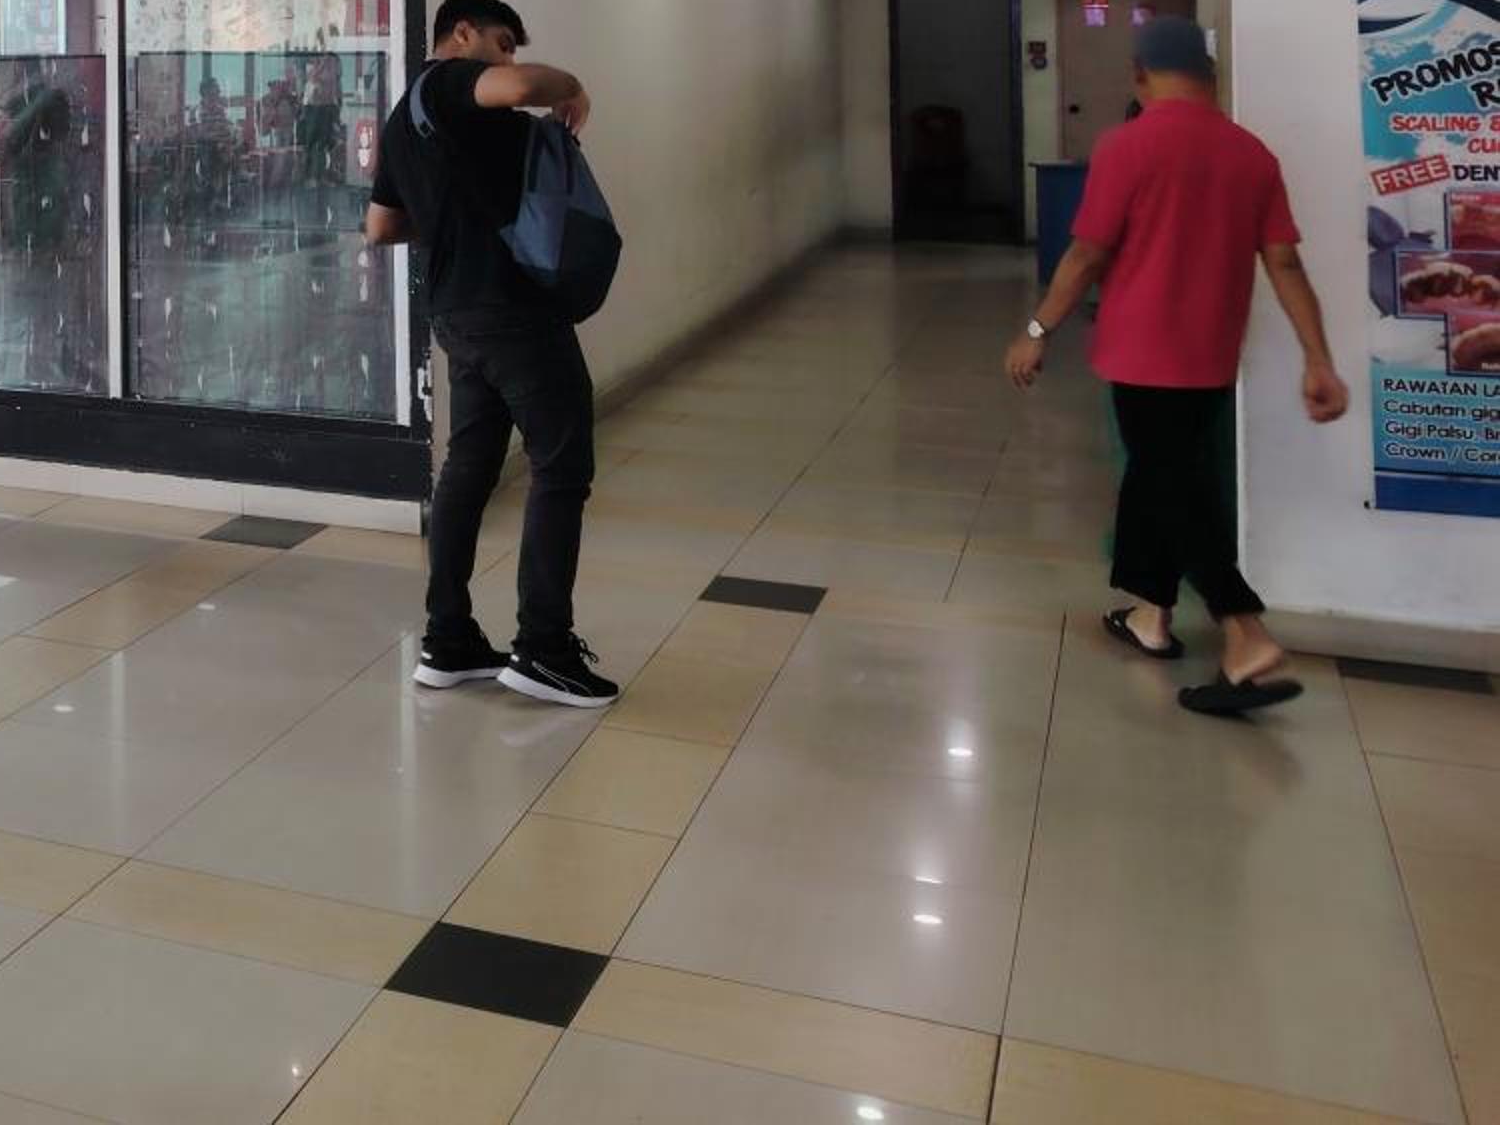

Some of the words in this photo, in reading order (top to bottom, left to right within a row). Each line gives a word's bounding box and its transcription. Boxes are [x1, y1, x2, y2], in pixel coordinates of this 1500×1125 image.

[1392, 115, 1481, 132] SCALING
[1374, 158, 1448, 193] FREE
[1383, 378, 1478, 396] RAWATAN
[1384, 398, 1467, 418] Cabutan
[1385, 421, 1422, 440] Gigi
[1385, 442, 1446, 459] Crown
